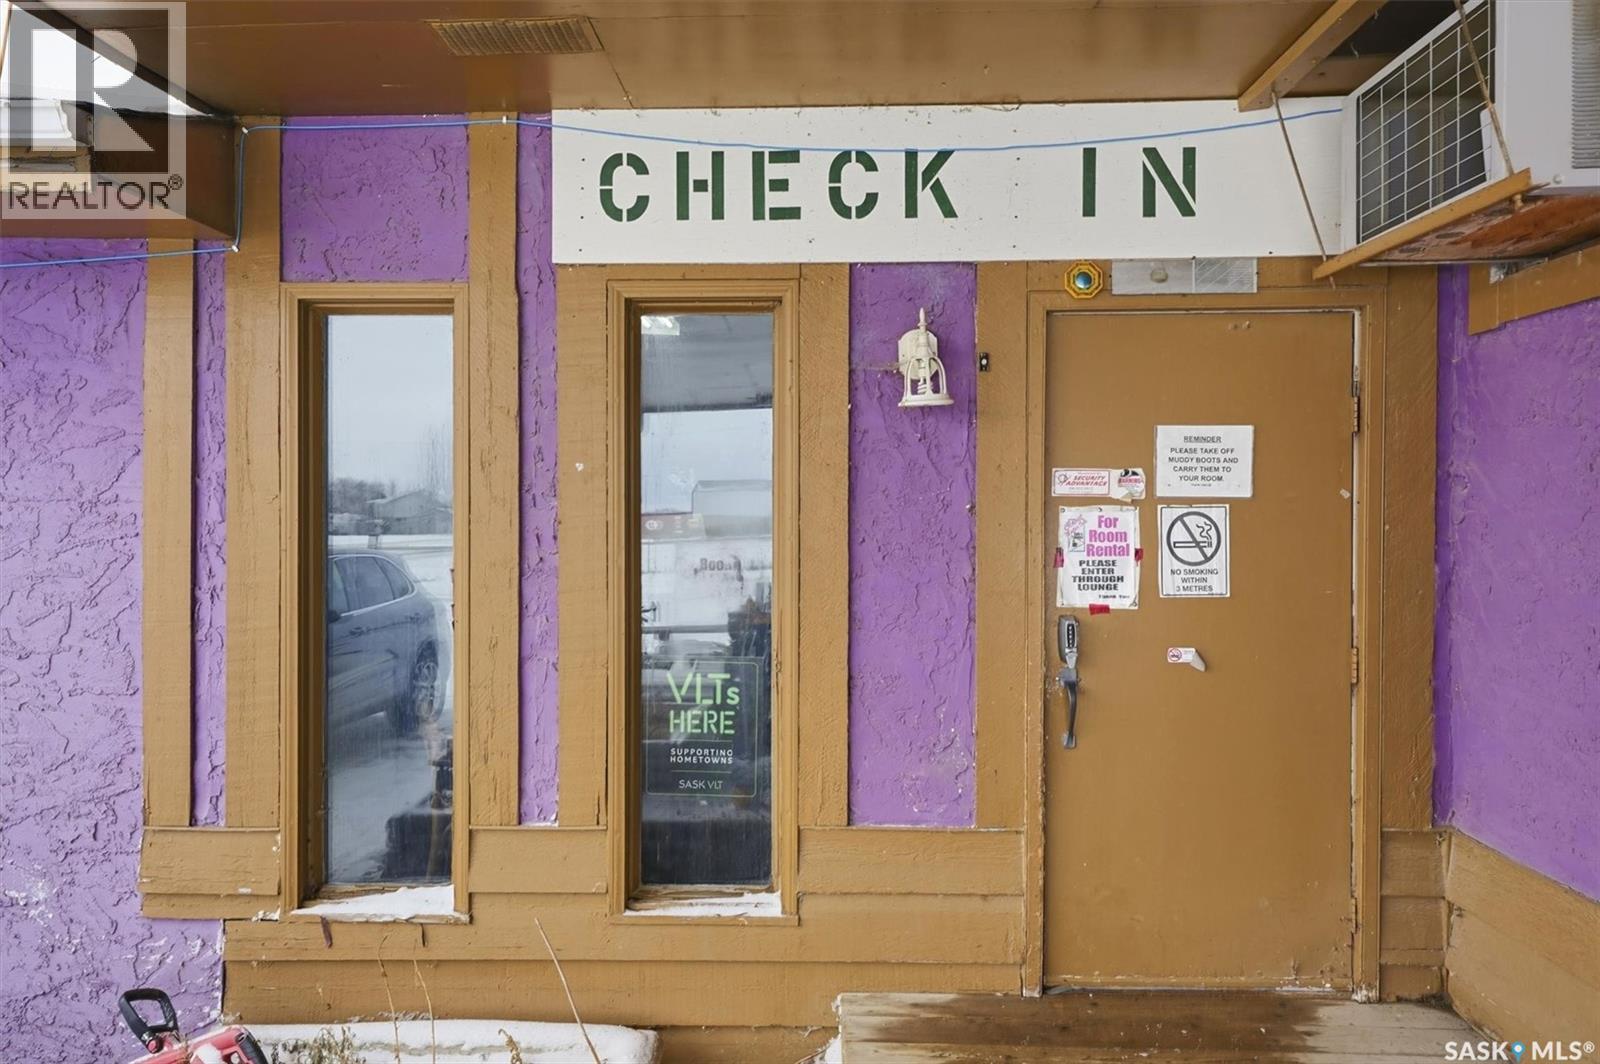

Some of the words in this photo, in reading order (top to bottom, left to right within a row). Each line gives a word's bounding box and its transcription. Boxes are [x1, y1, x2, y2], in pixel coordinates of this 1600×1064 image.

[599, 148, 959, 222] CHECK
[1081, 146, 1197, 218] IN
[1183, 435, 1222, 443] REMINDER
[1097, 515, 1119, 528] For
[1088, 530, 1128, 542] Room
[1086, 543, 1130, 557] Rental
[1079, 559, 1118, 567] PLEASE
[1081, 567, 1115, 575] ENTER
[1072, 575, 1124, 583] THROUGH
[1078, 583, 1119, 591] LOUNGE
[667, 672, 740, 706] VLTs
[669, 710, 736, 735] HERE
[670, 747, 734, 757] SUPPORTING
[670, 756, 734, 765] HOMETOWNS
[678, 779, 706, 790] SASK
[706, 780, 724, 790] VLT
